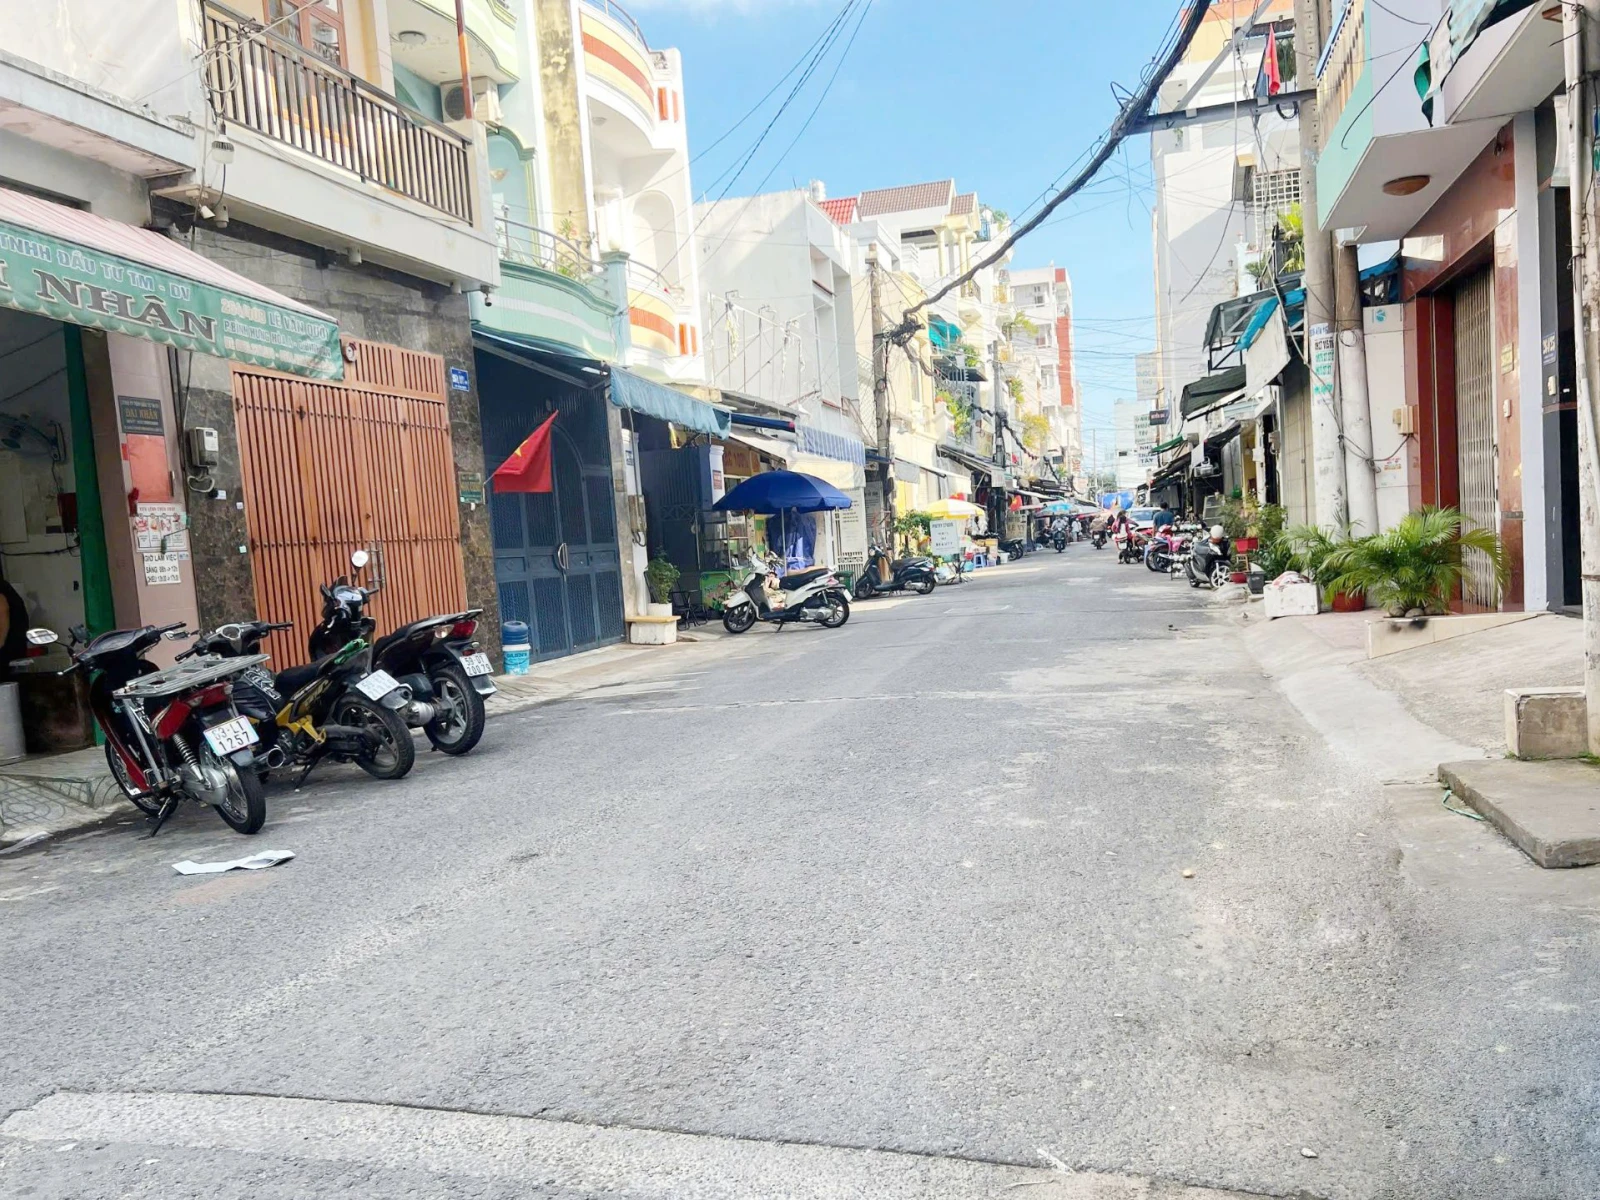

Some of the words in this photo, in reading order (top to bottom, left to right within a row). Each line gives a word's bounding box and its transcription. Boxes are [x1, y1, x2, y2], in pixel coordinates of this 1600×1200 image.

[0, 233, 52, 262] TNHH
[57, 249, 96, 275] ĐẦU
[101, 264, 125, 282] TƯ
[127, 270, 155, 291] TM
[169, 282, 191, 301] DV
[34, 269, 217, 343] NHÂN
[268, 310, 282, 328] LÊ
[218, 731, 250, 751] 1257
